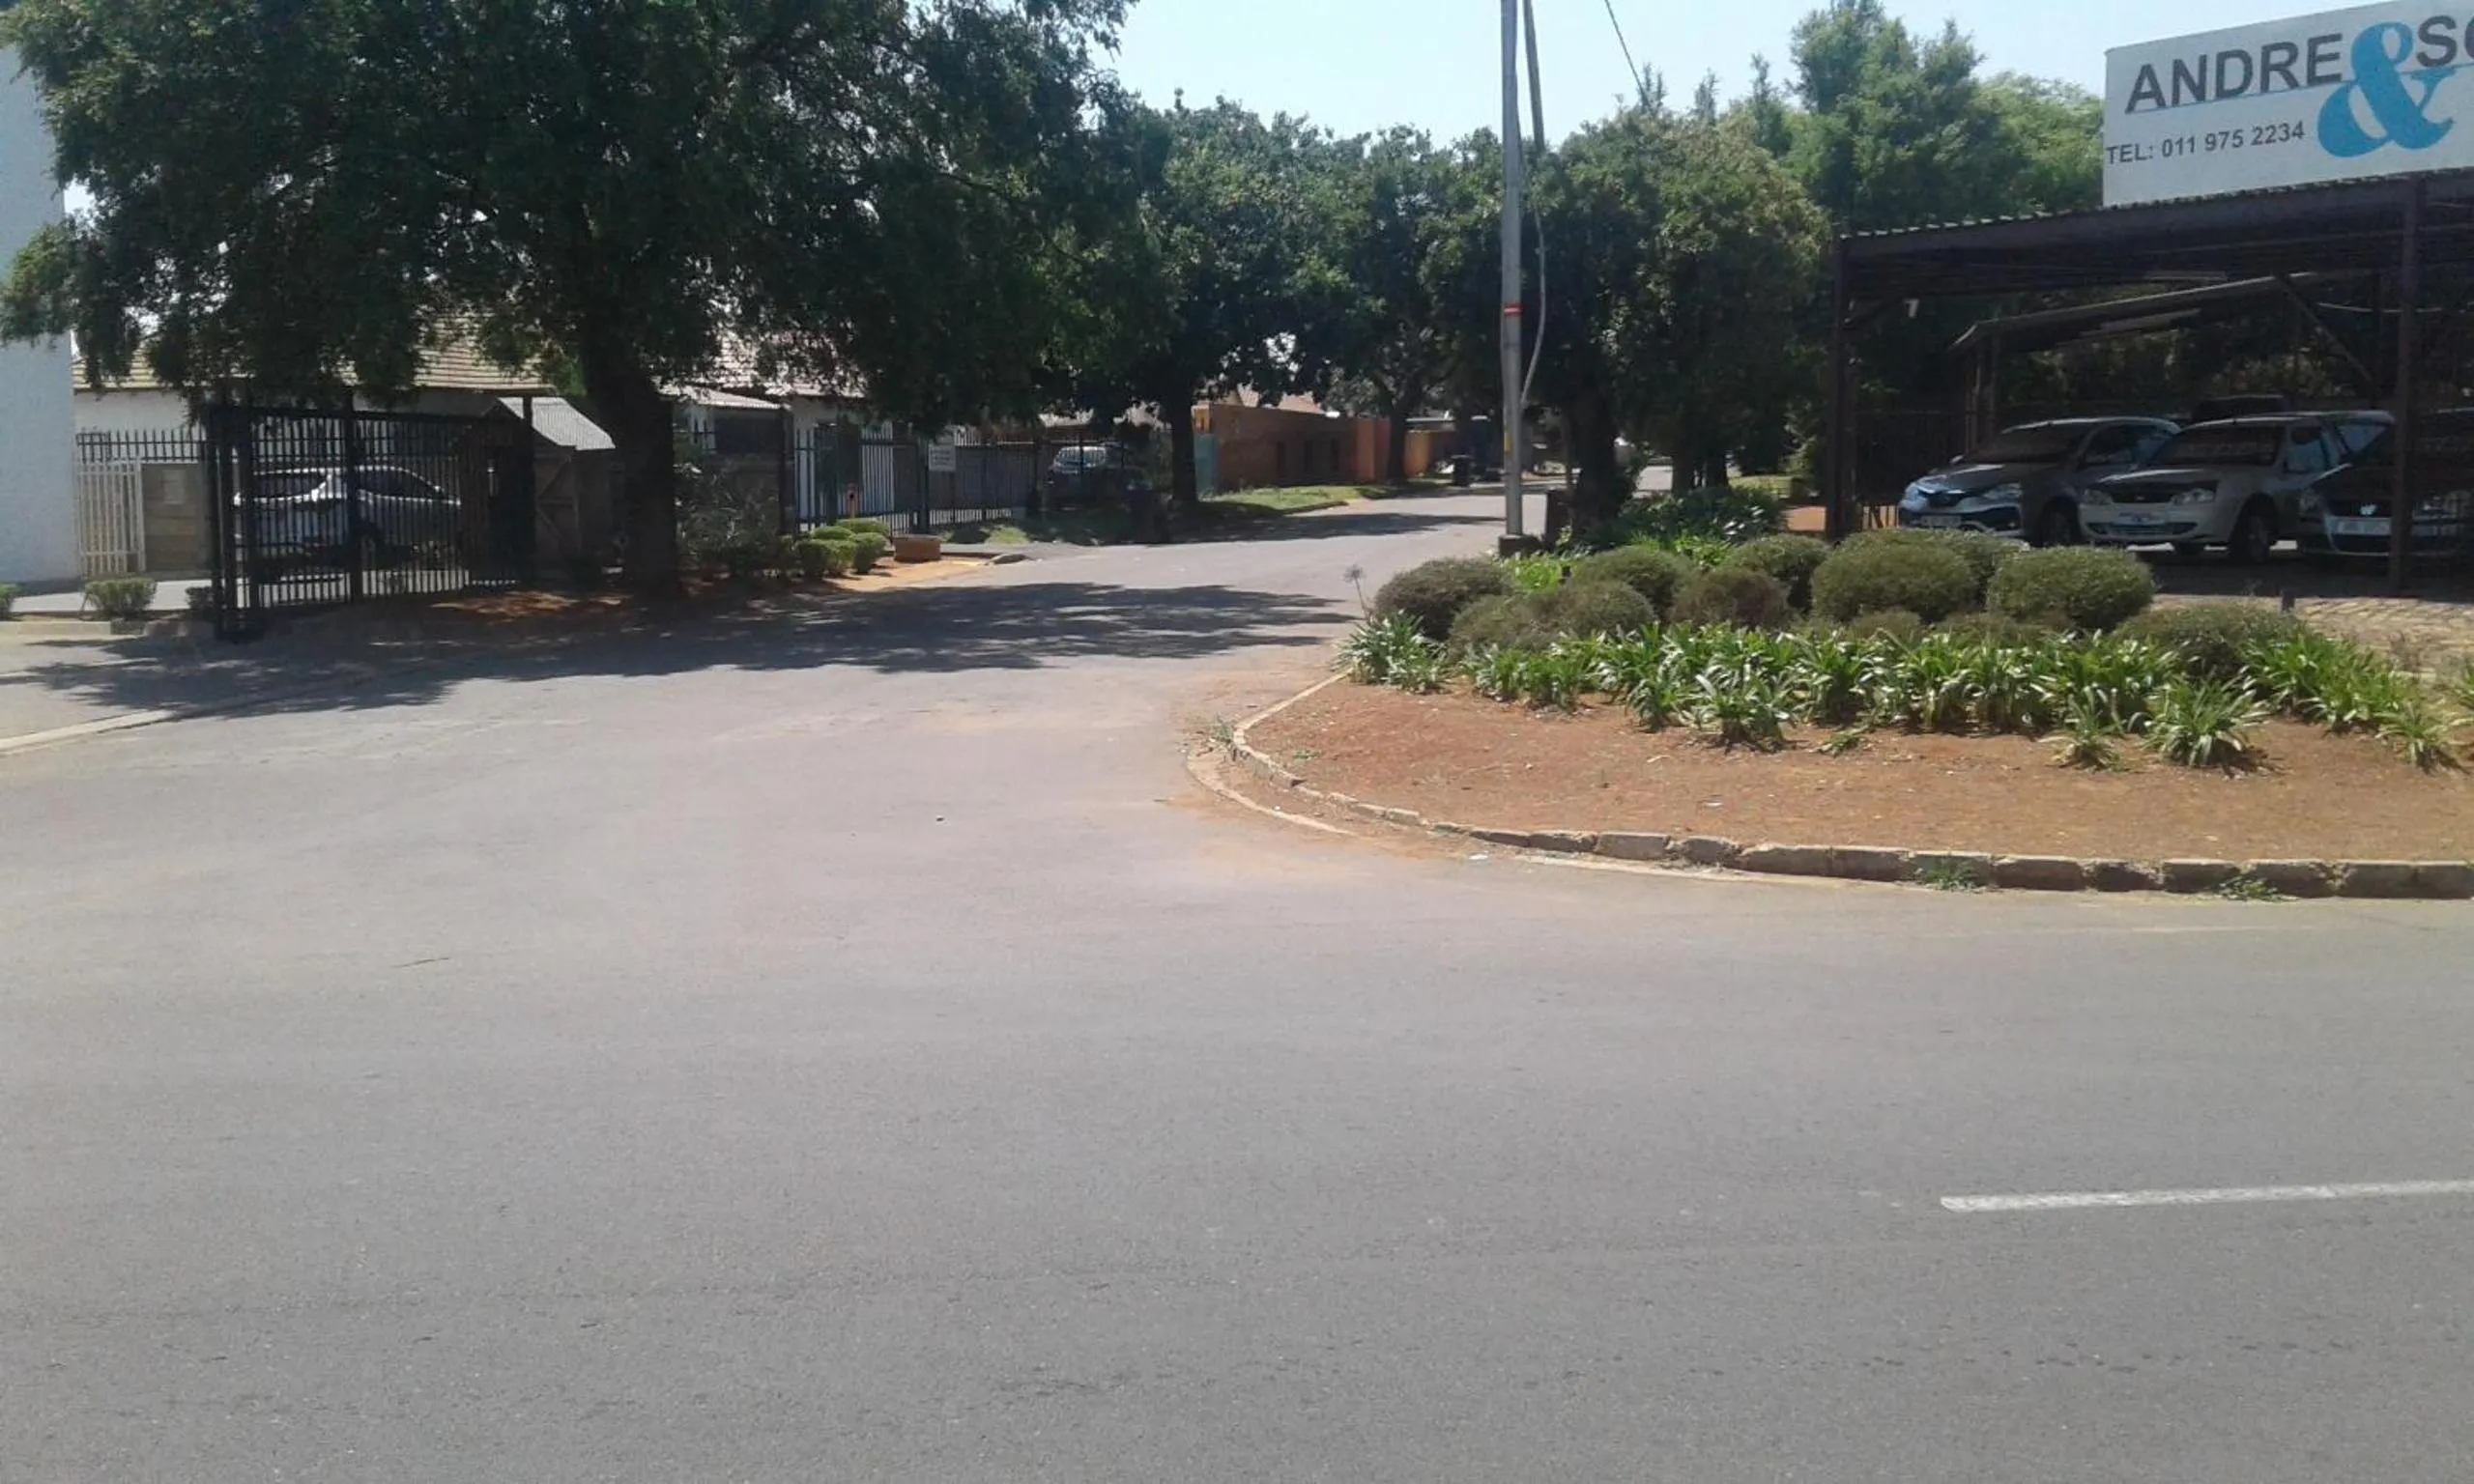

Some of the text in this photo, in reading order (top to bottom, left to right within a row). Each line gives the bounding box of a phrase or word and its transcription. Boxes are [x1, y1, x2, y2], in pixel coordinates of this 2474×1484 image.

[2125, 33, 2344, 114] ANDRE
[2416, 14, 2474, 67] S
[2106, 121, 2305, 164] TEL: 011 975 2234
